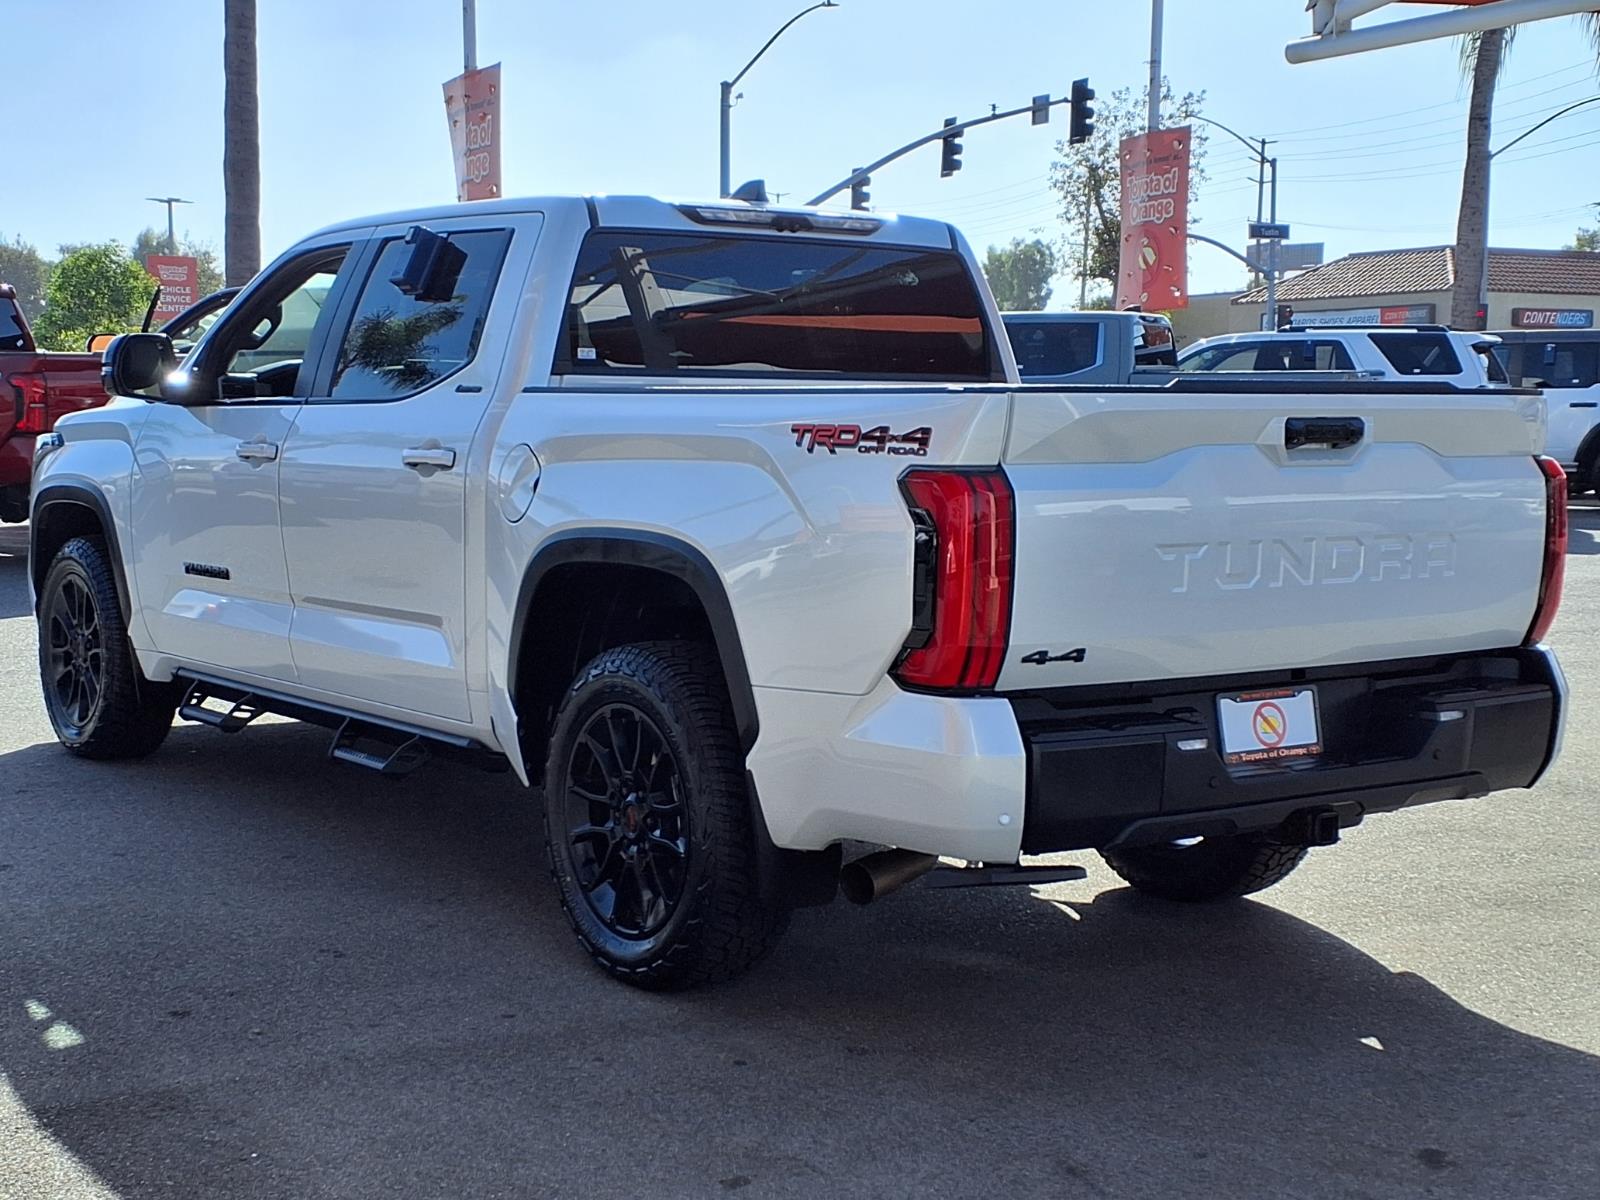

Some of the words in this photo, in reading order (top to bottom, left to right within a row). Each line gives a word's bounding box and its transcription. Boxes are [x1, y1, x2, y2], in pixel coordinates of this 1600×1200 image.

[1127, 173, 1163, 203] Toyota
[1162, 167, 1178, 193] of
[1130, 198, 1174, 225] Orange
[160, 294, 192, 303] ERVICE
[1523, 311, 1587, 324] CONTENDERS
[791, 423, 862, 455] TRD
[858, 445, 885, 454] OFF
[887, 447, 928, 457] ROAD
[1154, 531, 1457, 594] TUNDRA
[1240, 751, 1268, 761] Toyota
[1269, 750, 1278, 758] of
[1279, 747, 1307, 757] Orange
